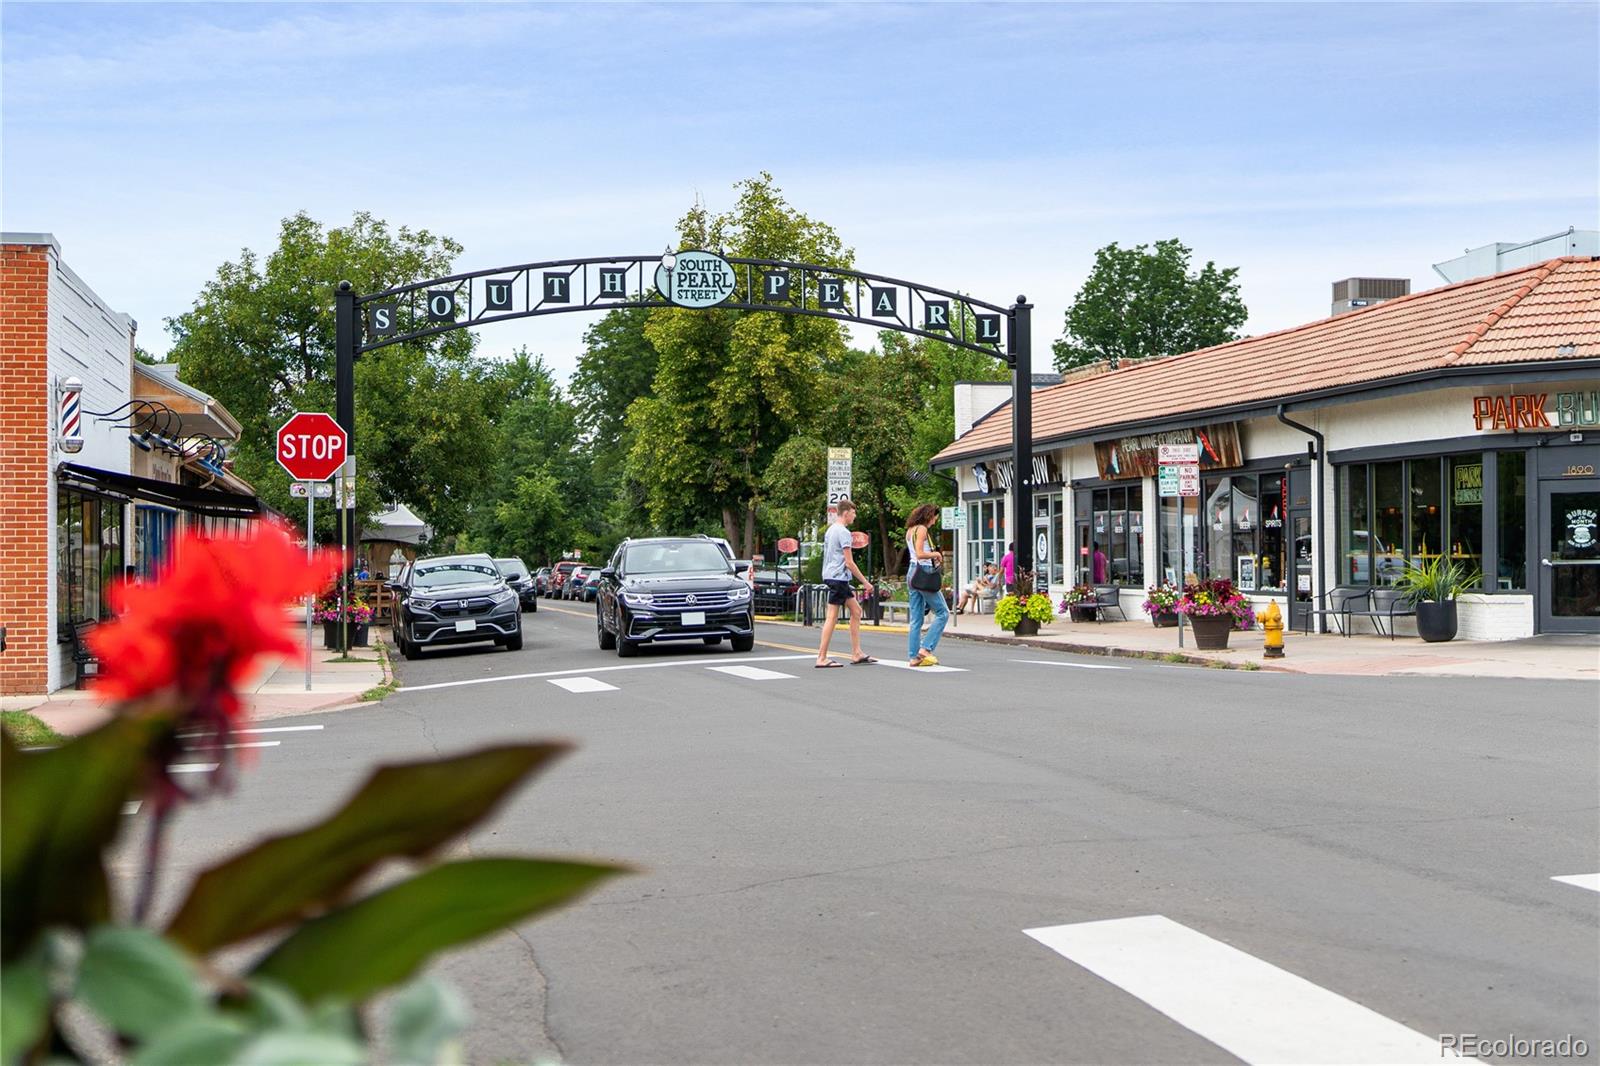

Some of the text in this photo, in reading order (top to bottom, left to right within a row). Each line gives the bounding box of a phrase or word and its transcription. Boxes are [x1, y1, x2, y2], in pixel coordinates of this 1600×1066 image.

[680, 258, 722, 272] SOUTH
[676, 272, 733, 294] PEARL
[375, 273, 999, 338] SOUTH PEARL
[677, 289, 718, 301] STREET
[1473, 393, 1551, 431] PARK
[282, 434, 342, 460] STOP
[1566, 509, 1597, 520] BURGER
